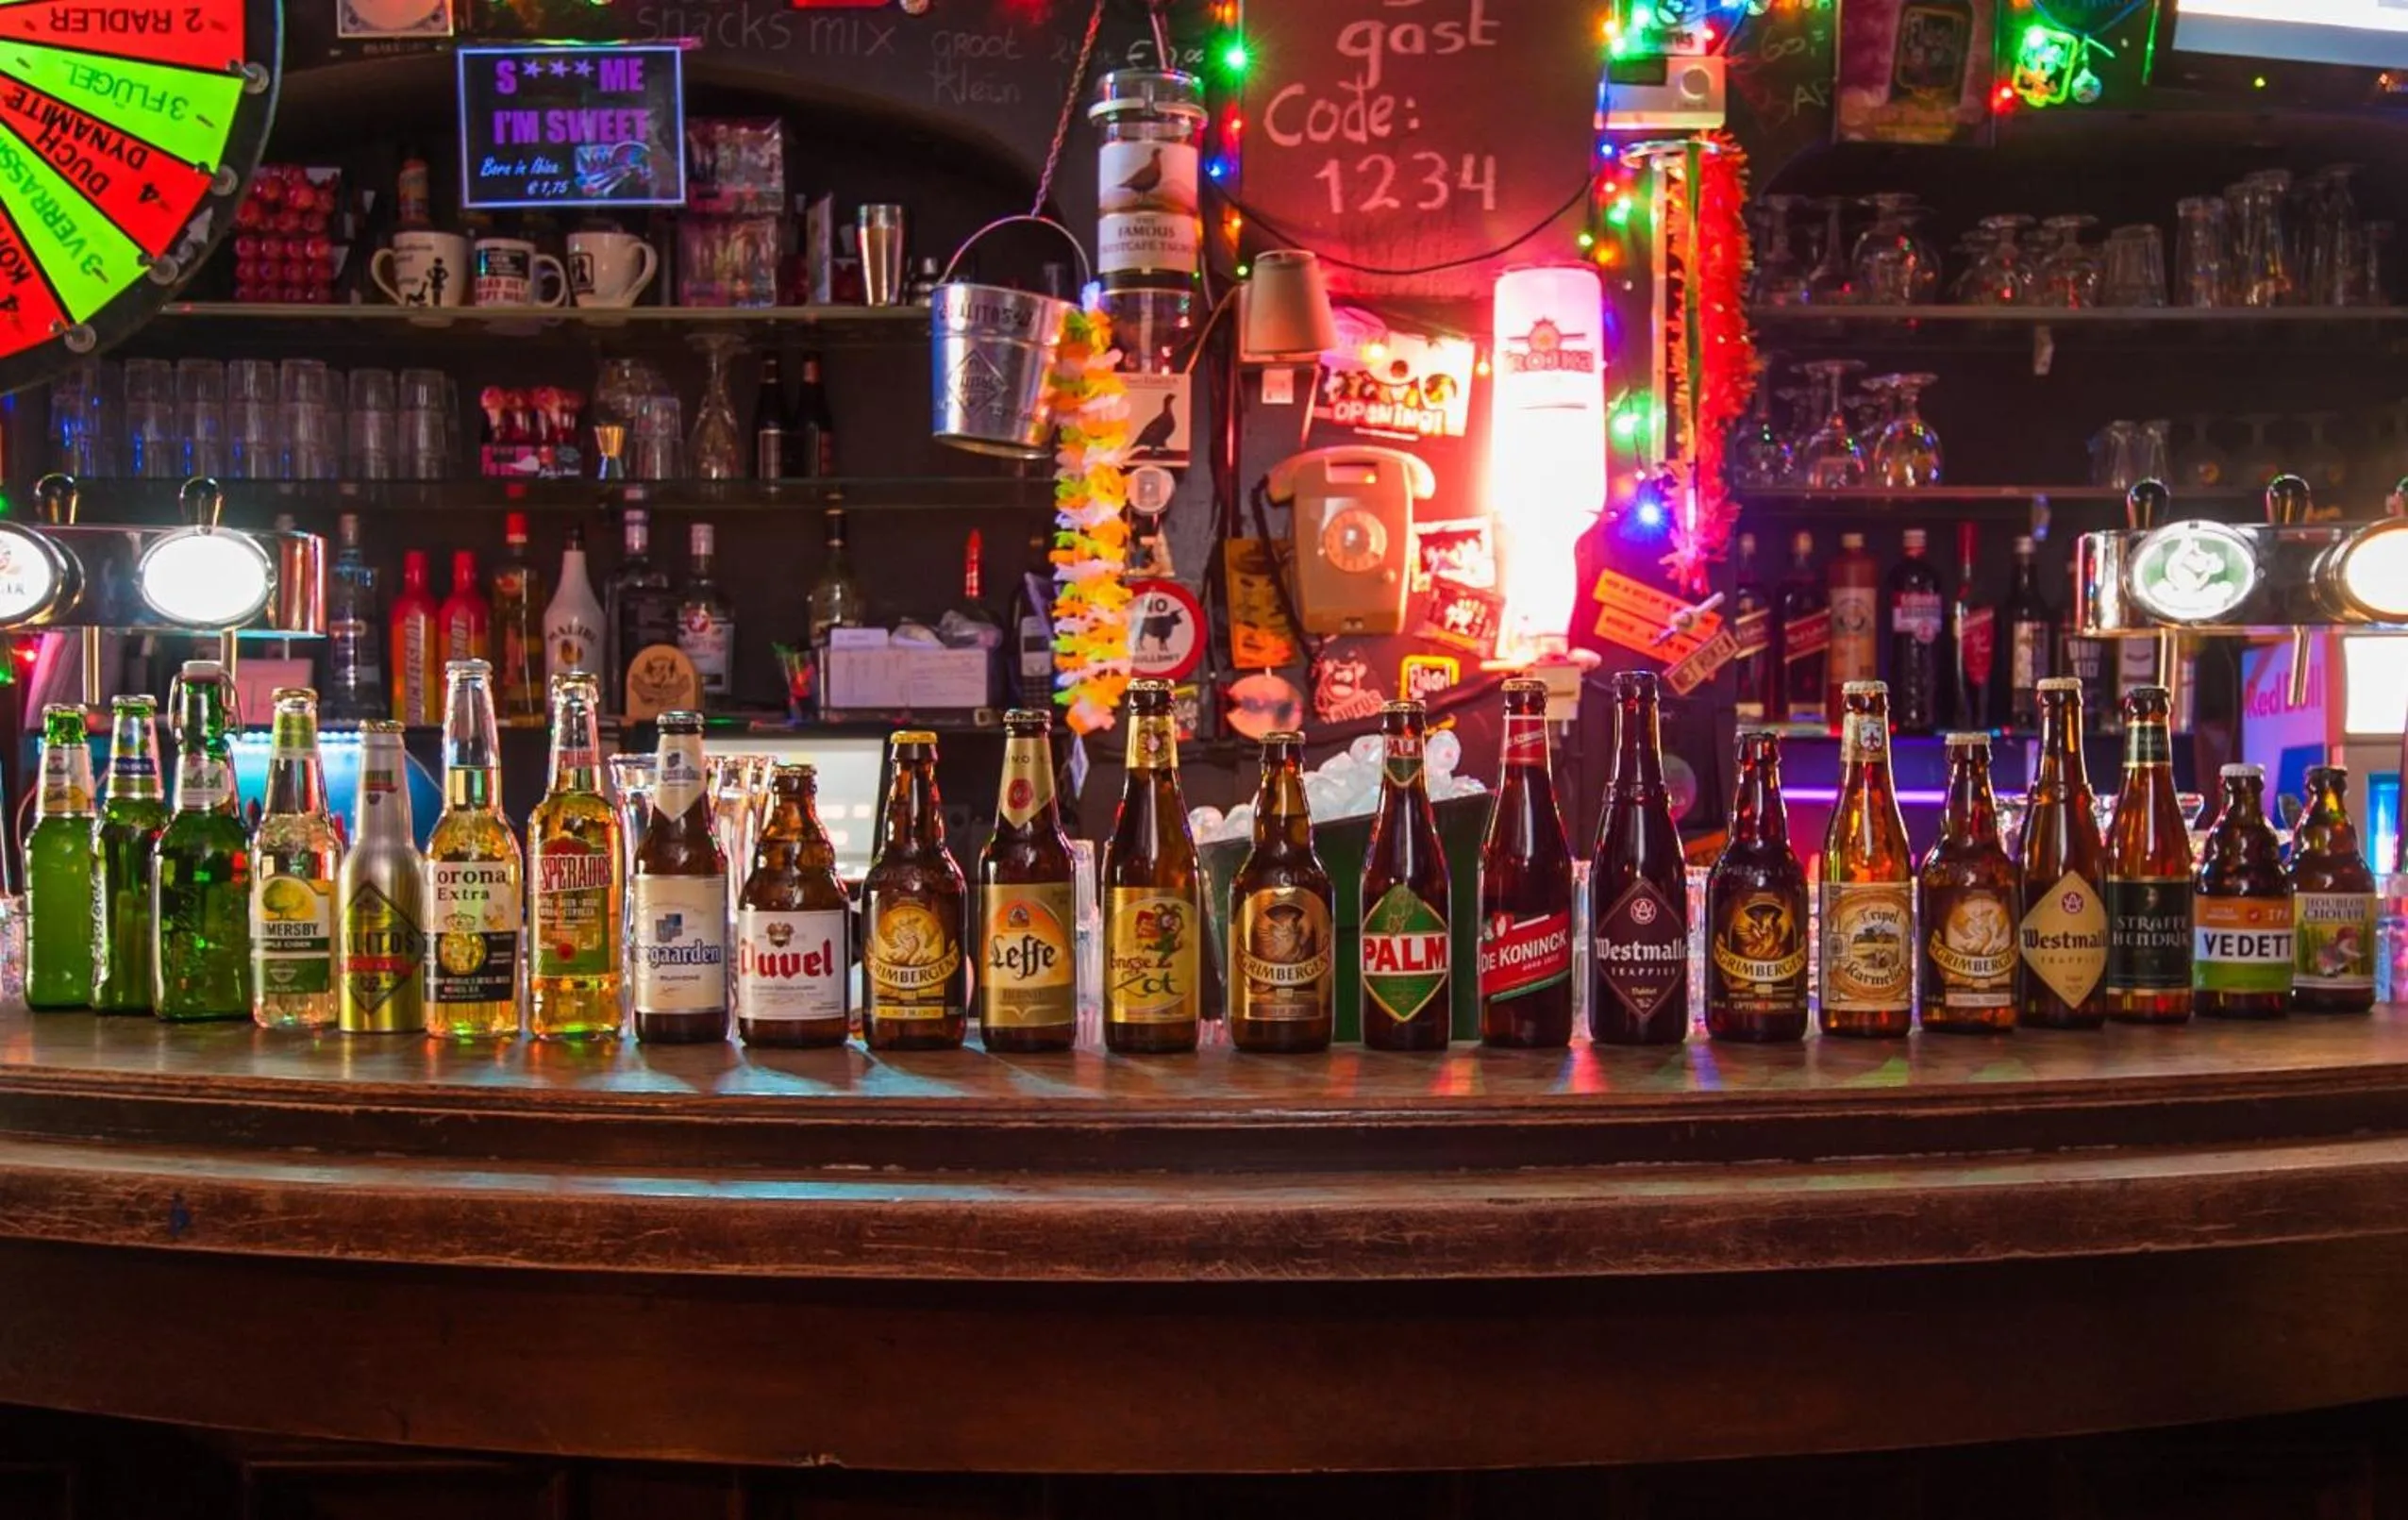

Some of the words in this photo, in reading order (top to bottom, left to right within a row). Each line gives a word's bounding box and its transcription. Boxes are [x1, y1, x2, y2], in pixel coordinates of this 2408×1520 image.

[50, 8, 172, 34] RADLER
[811, 13, 896, 56] mix
[1337, 0, 1501, 91] gast
[4, 87, 148, 171] DYNAMITE
[494, 110, 539, 145] I'M
[547, 109, 651, 144] SWEET
[1264, 72, 1420, 146] Code:
[36, 124, 110, 197] DUCH
[1314, 151, 1497, 214] 1234
[1118, 225, 1176, 239] FAMOUS
[437, 887, 491, 902] Extra
[989, 935, 1057, 980] Leffe
[1363, 934, 1446, 973] PALM
[1481, 951, 1497, 974] DE
[1498, 931, 1566, 967] KONINCK
